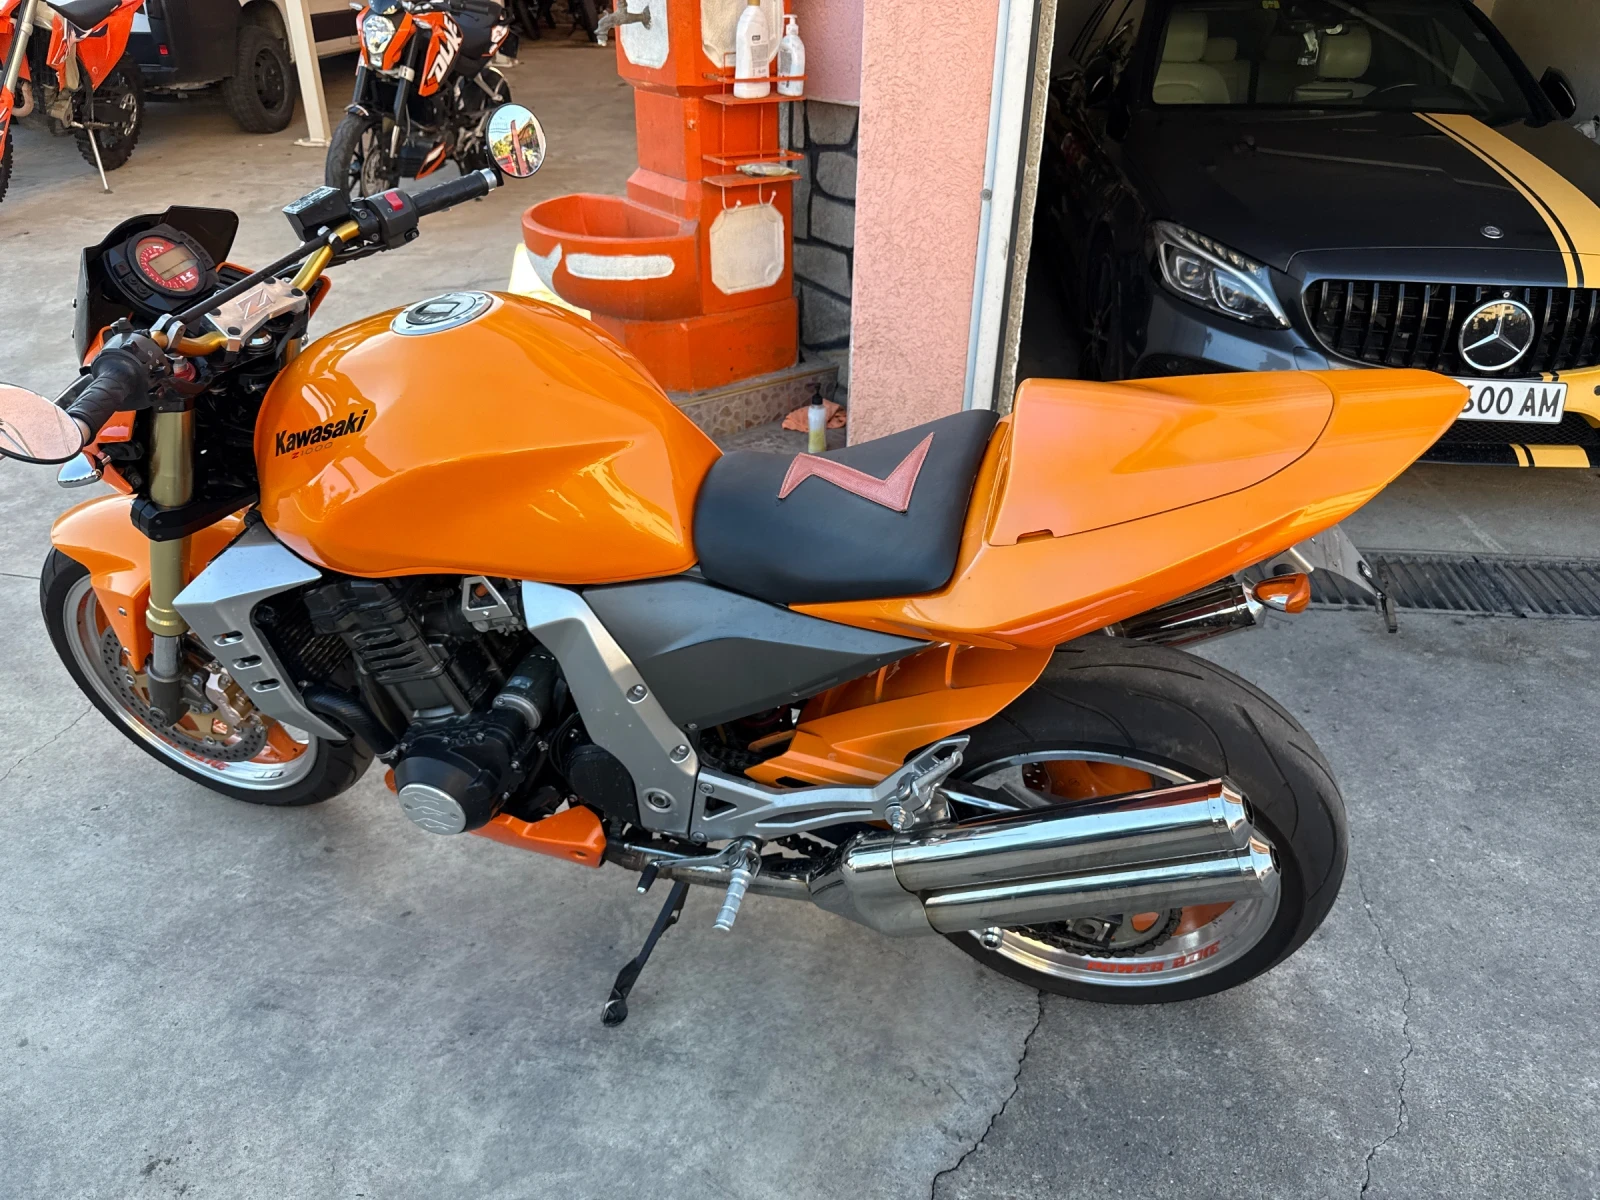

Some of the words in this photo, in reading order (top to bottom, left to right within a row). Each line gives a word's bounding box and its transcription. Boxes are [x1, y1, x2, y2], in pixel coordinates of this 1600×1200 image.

[427, 12, 462, 83] DUKE
[1517, 387, 1561, 418] AM
[275, 408, 370, 457] Kawasaki
[291, 441, 334, 460] Z1000
[1087, 961, 1165, 974] POWER
